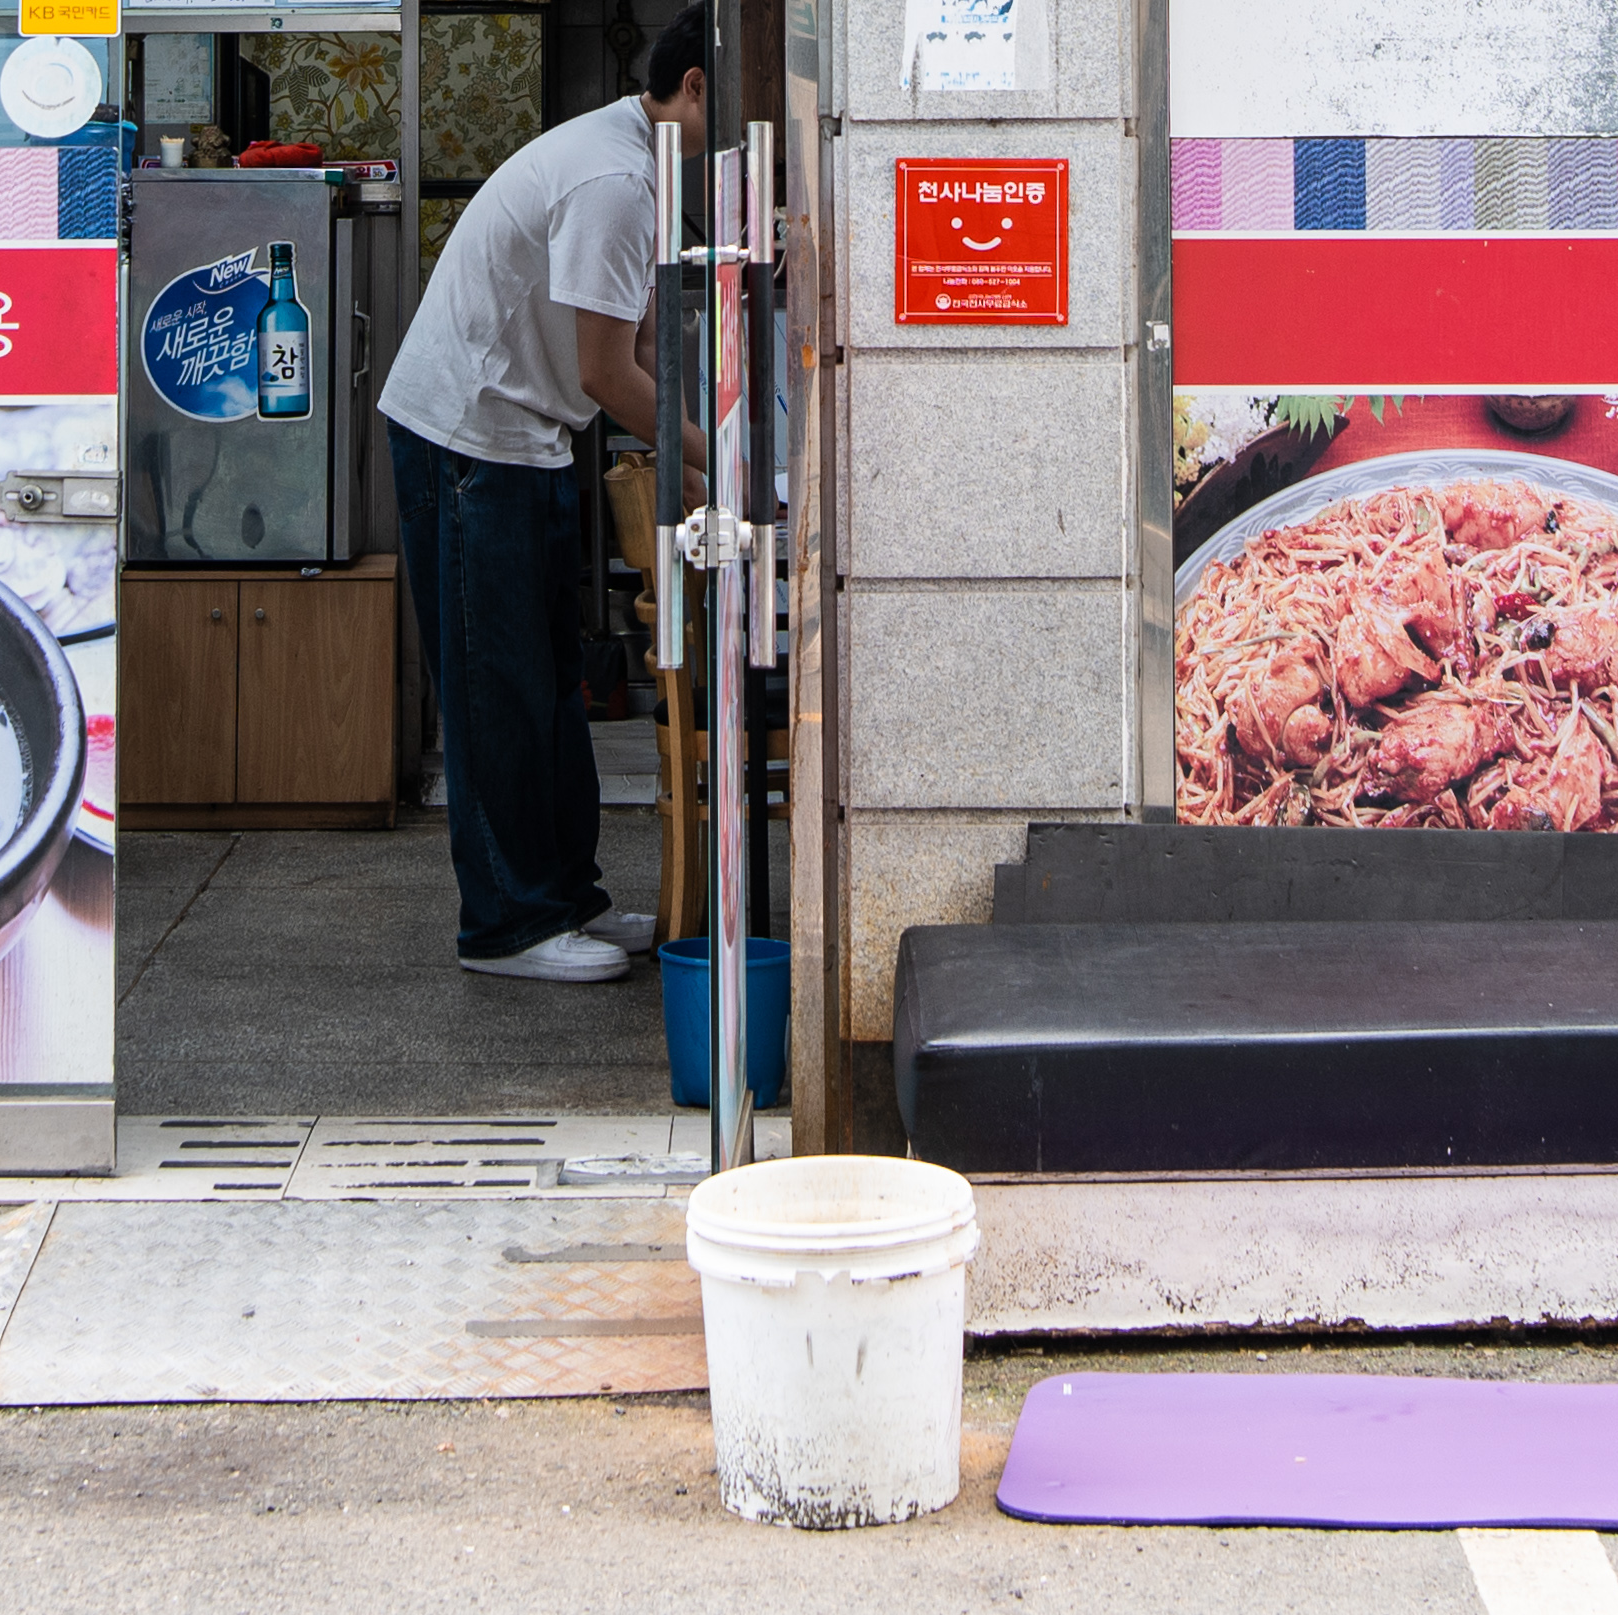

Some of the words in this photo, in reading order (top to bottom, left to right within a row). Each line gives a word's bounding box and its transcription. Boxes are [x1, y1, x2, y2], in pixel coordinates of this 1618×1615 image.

[29, 6, 54, 20] KB
[58, 5, 111, 21] 국민카드
[918, 181, 1046, 204] 천사나눔인증
[209, 257, 248, 287] New
[149, 309, 183, 333] 새로운
[156, 306, 234, 362] 새로운
[176, 329, 257, 386] 깨끗함
[272, 344, 299, 380] 참
